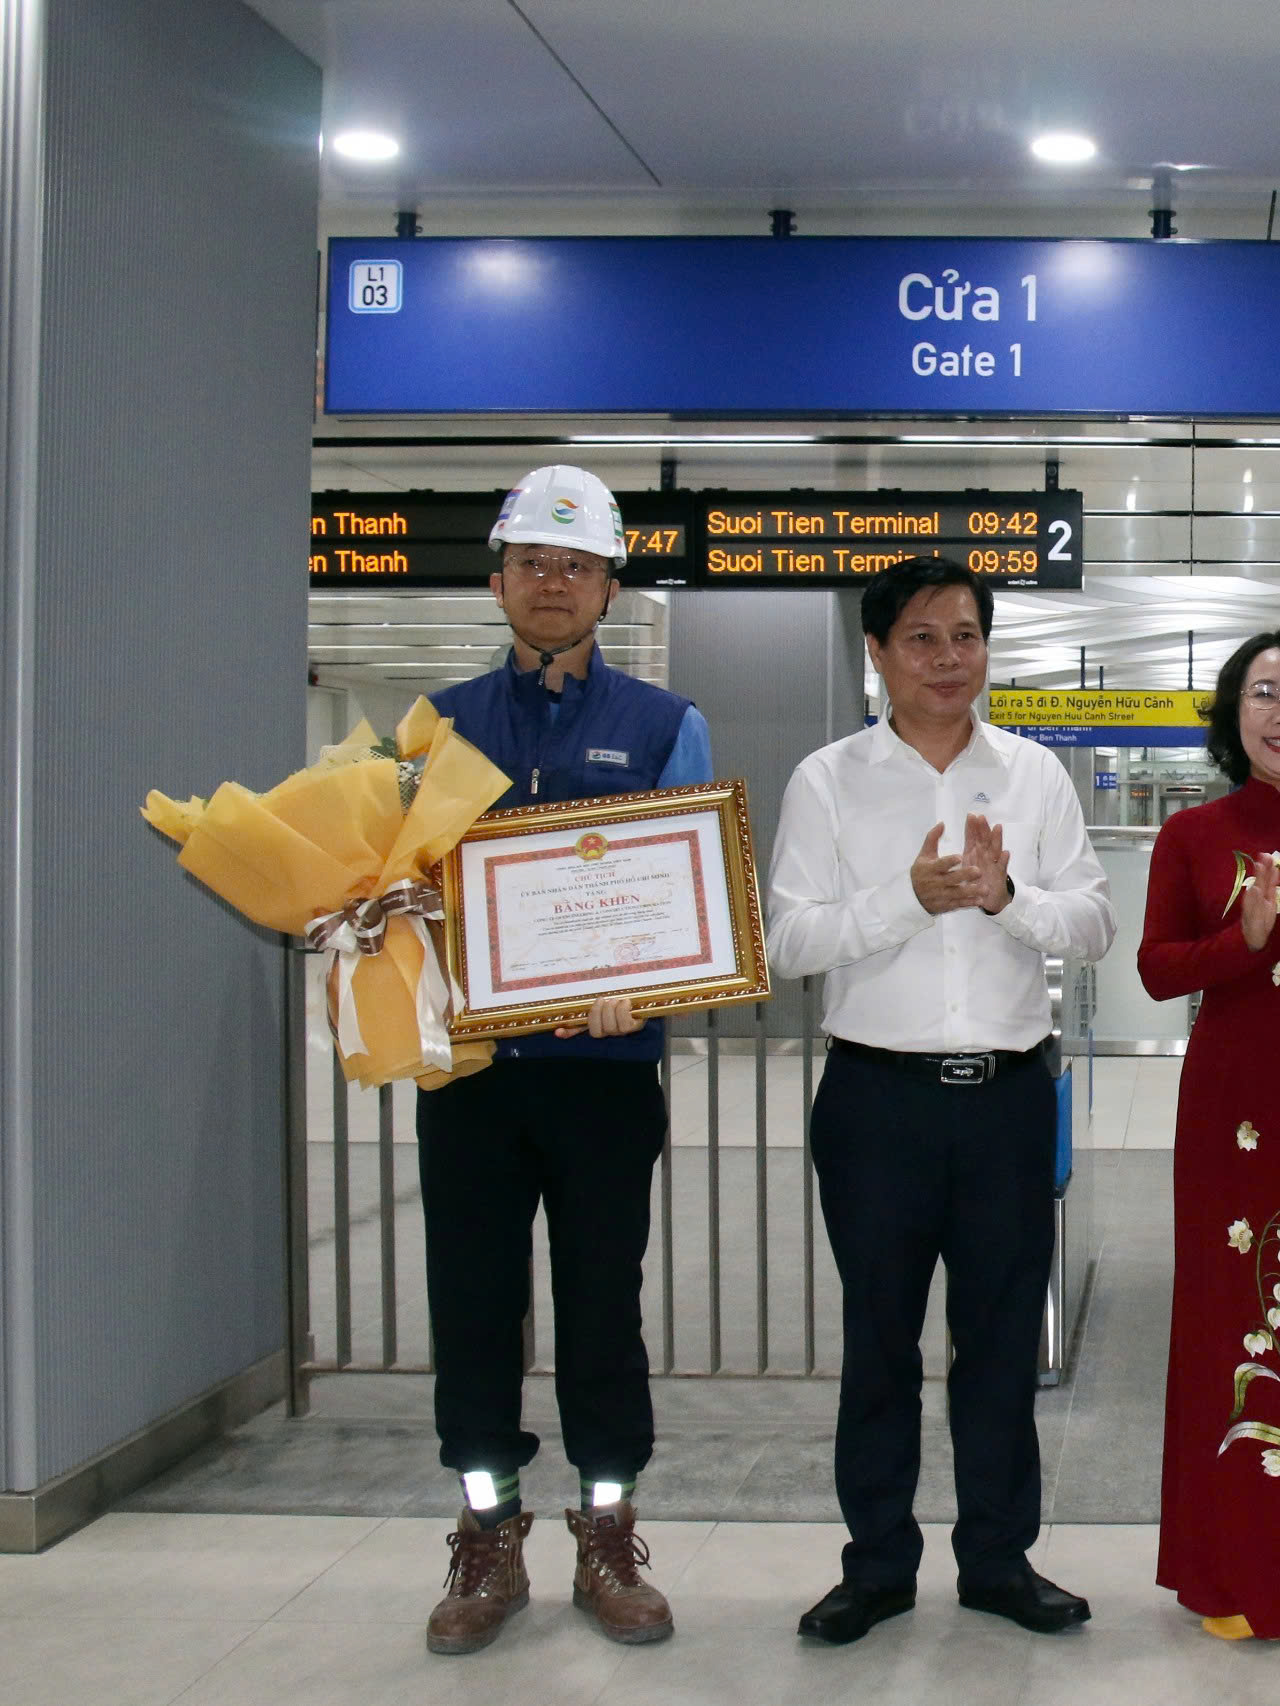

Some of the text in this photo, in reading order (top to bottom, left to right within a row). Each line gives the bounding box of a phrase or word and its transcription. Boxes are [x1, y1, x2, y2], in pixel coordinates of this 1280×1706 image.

[368, 267, 384, 281] L1
[362, 285, 388, 306] 03
[898, 268, 1037, 321] Cửa 1
[912, 342, 1021, 377] Gate 1
[333, 513, 408, 535] Thanh
[707, 511, 1038, 535] Suoi Tien Terminal 09:42
[1047, 520, 1073, 561] 2
[334, 550, 408, 573] Thanh
[707, 550, 762, 573] Suoi
[771, 550, 825, 573] Tien
[967, 550, 1038, 573] 09:59
[1010, 698, 1023, 708] ra
[1026, 696, 1033, 708] 5
[1036, 696, 1048, 708] đi
[1066, 695, 1110, 711] Nguyễn
[1115, 695, 1141, 708] Hữu
[1143, 696, 1174, 709] Cảnh
[989, 711, 1135, 723] Exit 5 for Nguyen Huu Canh Street
[1039, 734, 1053, 742] Ben
[1054, 734, 1078, 742] Thanh
[600, 894, 641, 908] KHEN
